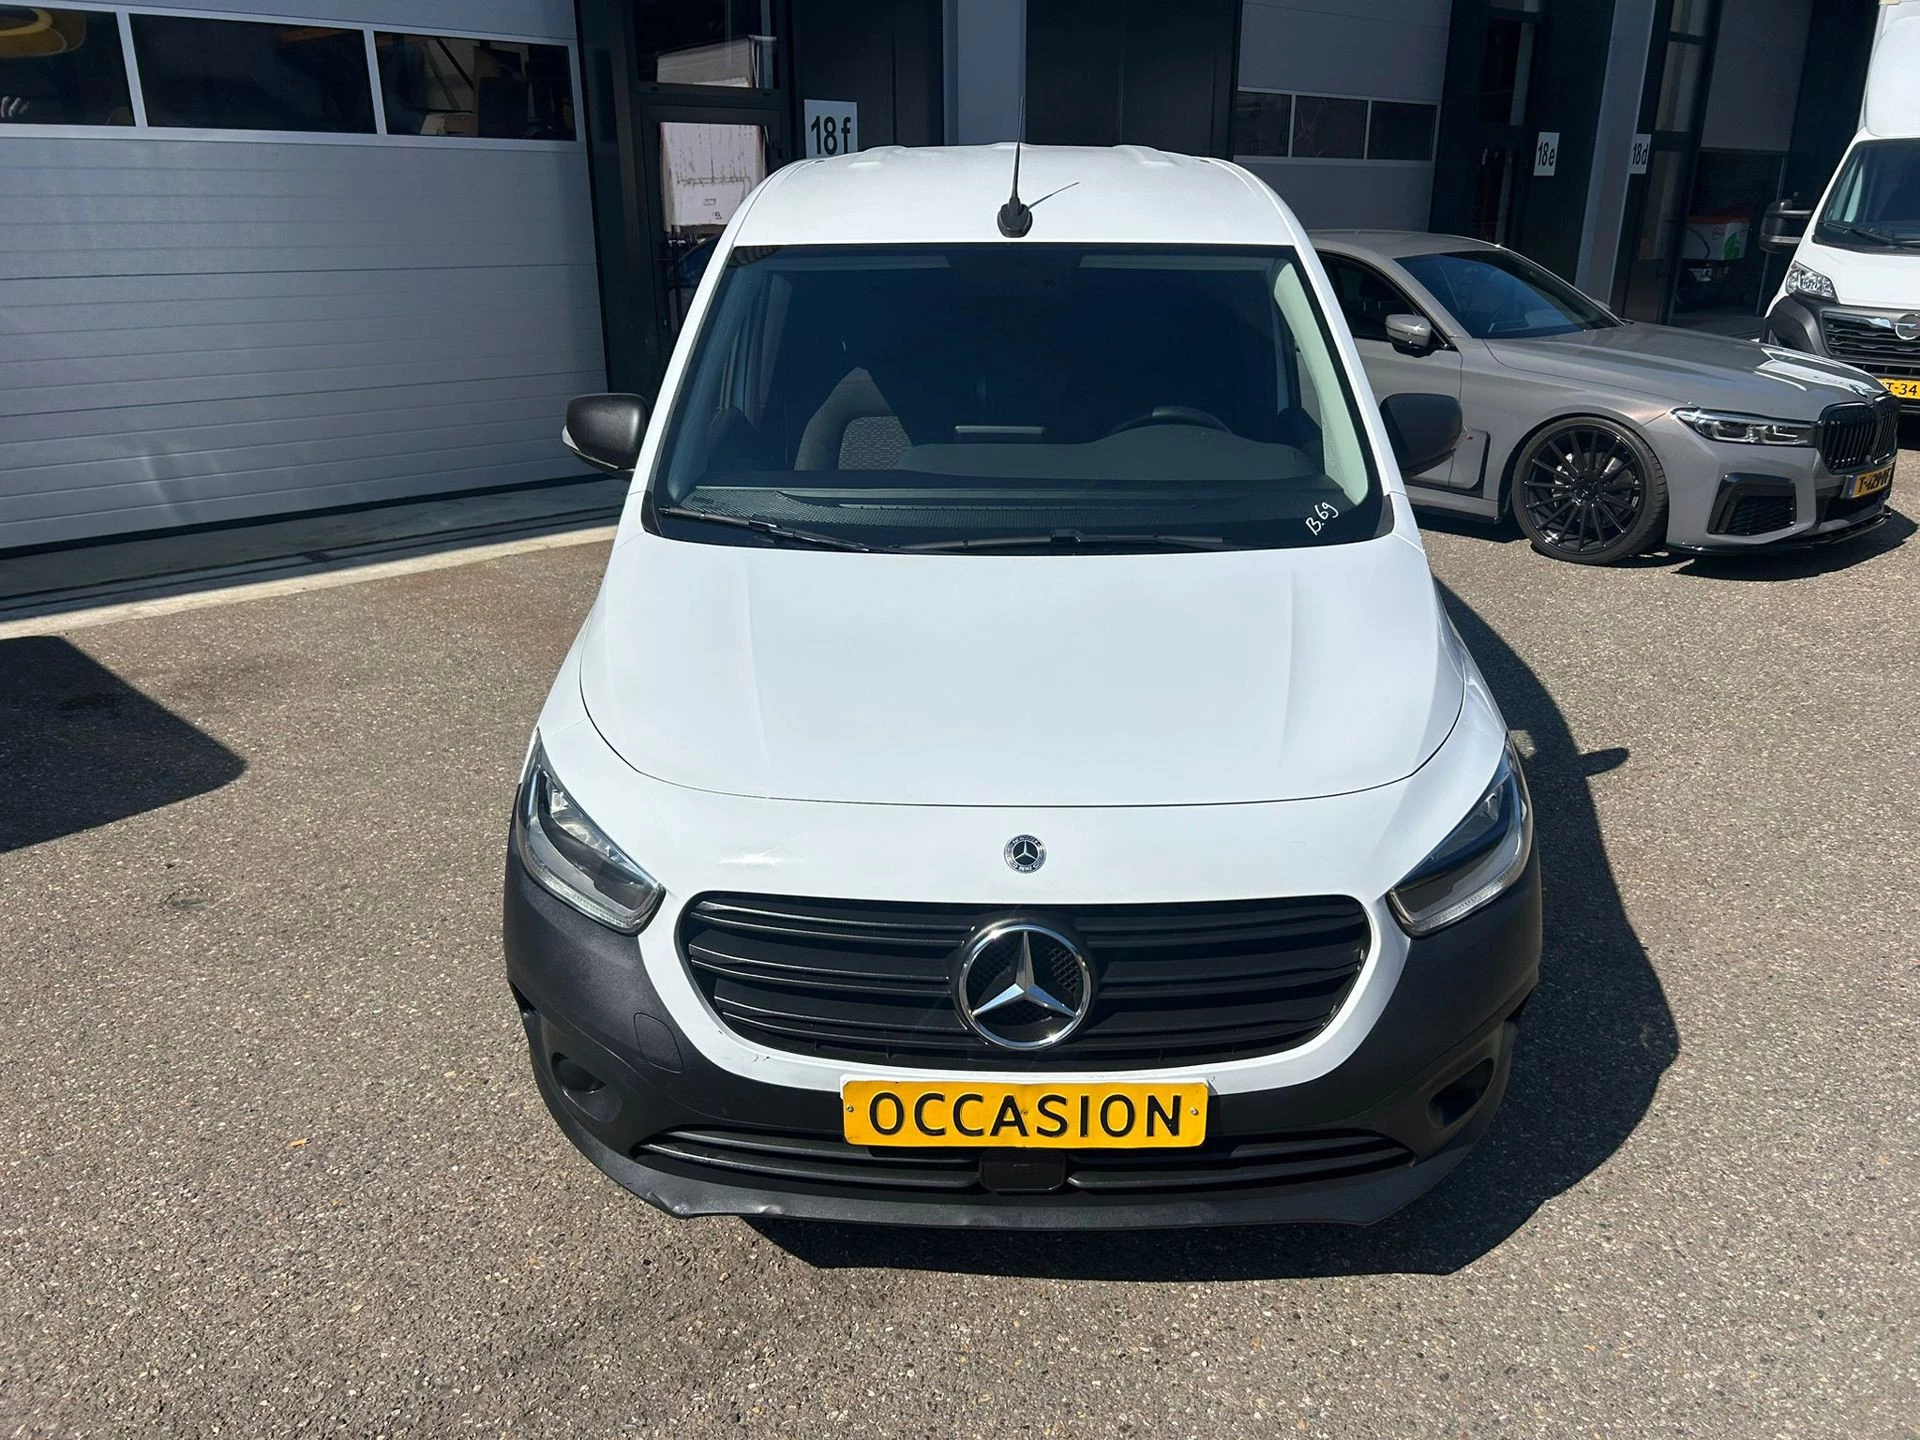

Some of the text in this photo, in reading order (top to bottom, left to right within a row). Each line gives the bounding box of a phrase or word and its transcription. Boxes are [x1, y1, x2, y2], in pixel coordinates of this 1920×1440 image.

[1537, 142, 1555, 167] 18e
[1631, 143, 1649, 165] 18d
[1882, 381, 1919, 396] T-34
[868, 1092, 1182, 1138] OCCASION
